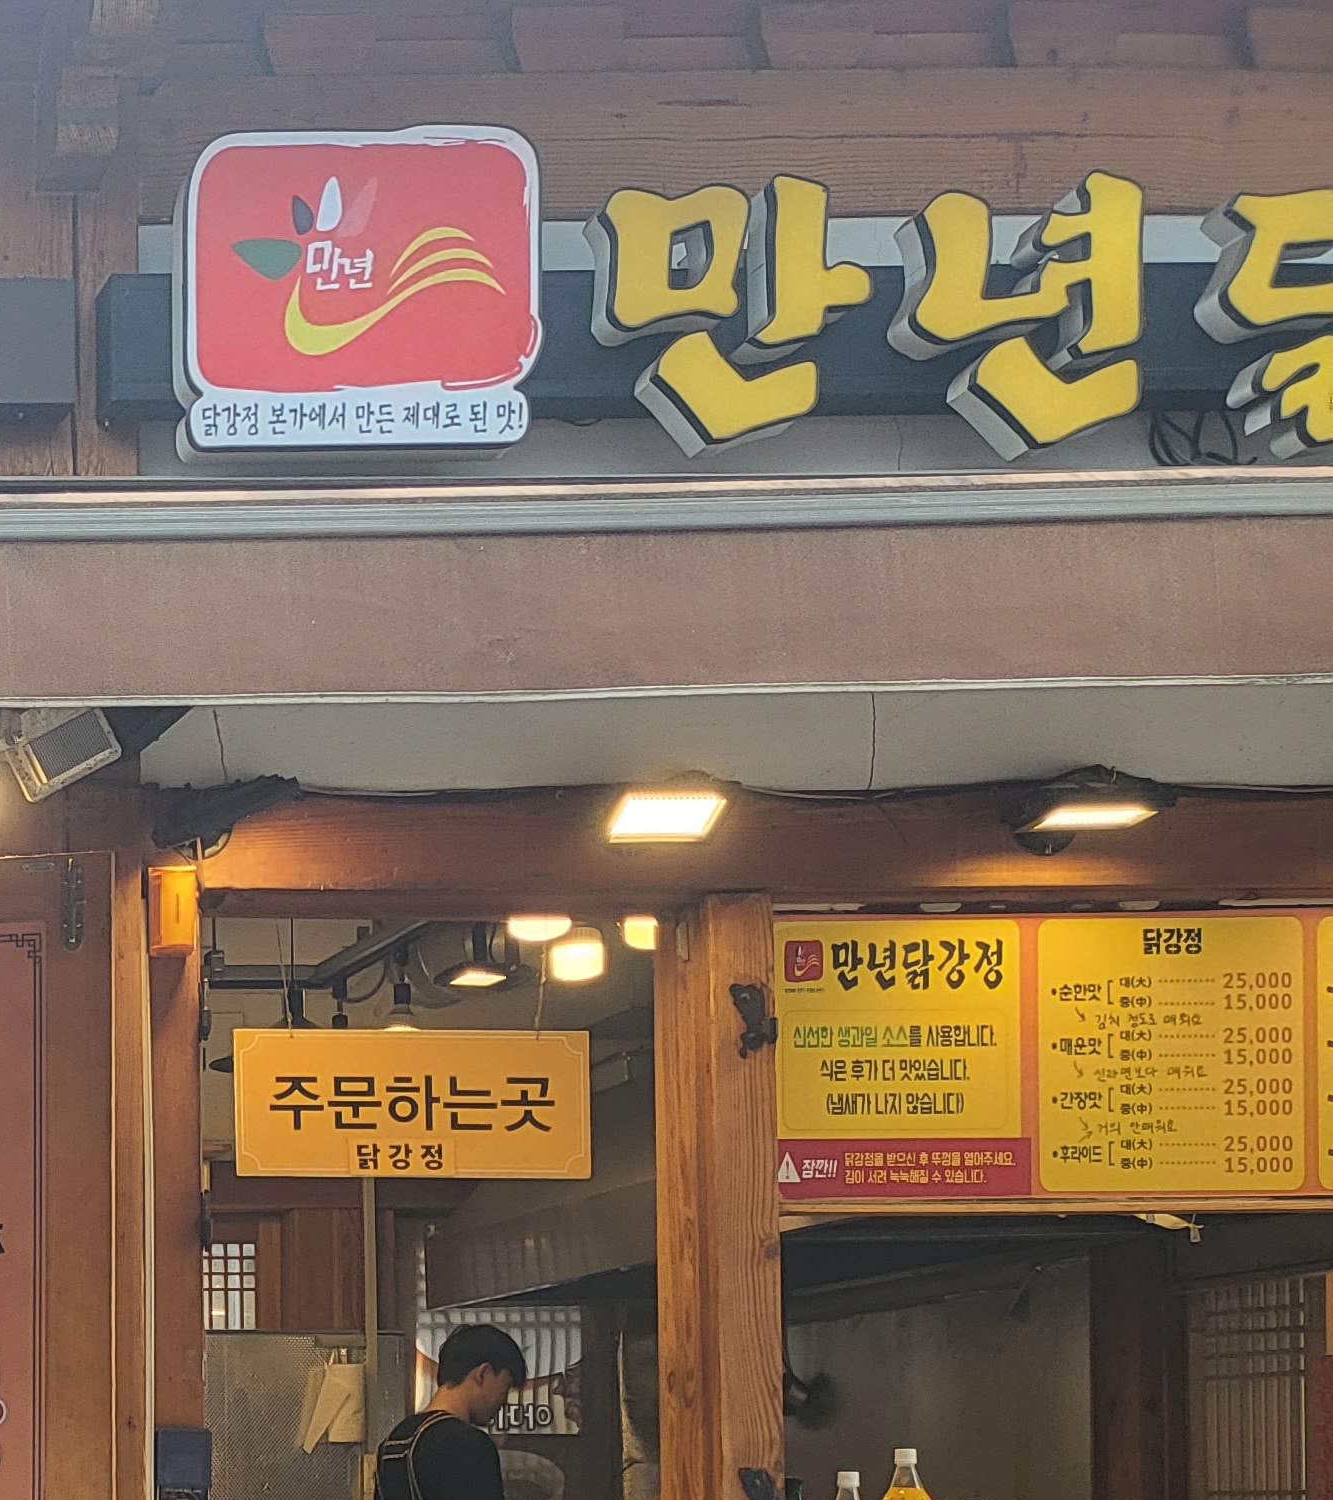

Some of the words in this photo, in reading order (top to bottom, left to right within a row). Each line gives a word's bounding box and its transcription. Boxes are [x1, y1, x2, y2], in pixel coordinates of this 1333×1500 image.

[306, 240, 374, 290] 만년
[202, 403, 259, 437] 닭강정
[268, 402, 347, 435] 본가에서
[355, 401, 395, 434] 만든
[402, 401, 462, 430] 제대로
[468, 400, 488, 434] 된
[496, 399, 524, 434] 맛!
[1142, 927, 1203, 955] 닭강정
[831, 938, 1004, 991] 만년닭강정
[1119, 976, 1152, 989] 대(大)
[1222, 972, 1293, 990] 25,000
[1059, 983, 1102, 1002] 순한맛
[1223, 993, 1293, 1011] 15,000
[1095, 1013, 1121, 1030] 김치
[1163, 1013, 1203, 1026] 매워요
[793, 1025, 833, 1049] 신선한
[837, 1025, 878, 1049] 생과일
[881, 1026, 922, 1048] 소스를
[926, 1024, 998, 1048] 사용합니다.
[1119, 1030, 1152, 1042] 대(大)
[1222, 1027, 1293, 1045] 25,000
[1059, 1038, 1102, 1056] 매운맛
[1223, 1048, 1293, 1067] 15,000
[820, 1058, 847, 1082] 식은
[850, 1058, 879, 1082] 후가
[882, 1058, 896, 1082] 더
[899, 1058, 971, 1082] 맛있습니다.
[1094, 1067, 1158, 1082] 신라면보다
[1120, 1083, 1152, 1096] 대(大)
[1223, 1078, 1293, 1097] 25,000
[269, 1074, 556, 1132] 주문하는곳
[826, 1092, 872, 1116] (냄새가
[874, 1092, 902, 1116] 나지
[905, 1092, 965, 1116] 않습니다)
[1059, 1091, 1103, 1110] 간장맛
[1223, 1099, 1293, 1117] 15,000
[1120, 1139, 1153, 1151] 대(大)
[1223, 1135, 1294, 1153] 25,000
[356, 1143, 444, 1171] 닭강정
[844, 1151, 884, 1168] 닭강정을
[886, 1151, 918, 1167] 받으신
[919, 1151, 930, 1167] 후
[931, 1151, 961, 1168] 뚜껑을
[963, 1151, 1017, 1168] 열어주세요.
[1059, 1145, 1103, 1164] 후라이드
[801, 1159, 838, 1180] 잠깐!!
[1224, 1156, 1294, 1175] 15,000
[844, 1169, 865, 1185] 김이
[931, 1170, 942, 1184] 수
[944, 1169, 988, 1184] 있습니다.
